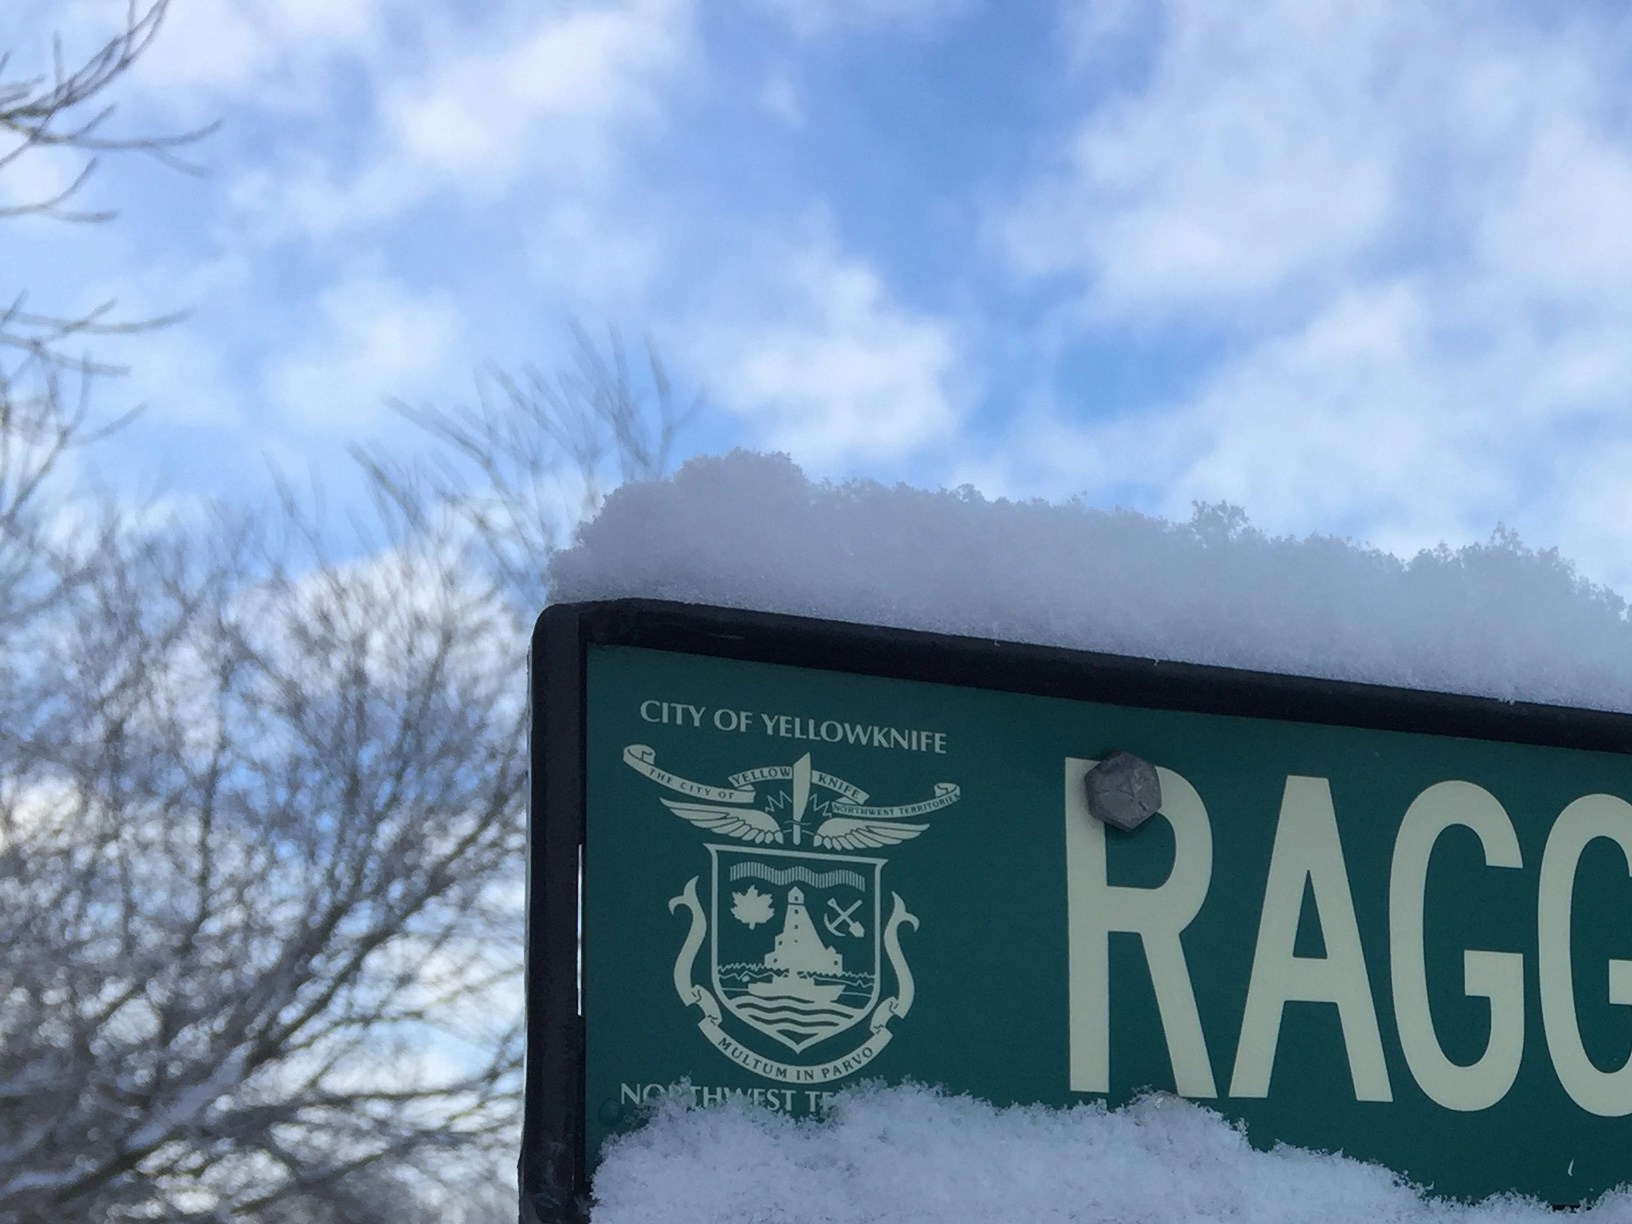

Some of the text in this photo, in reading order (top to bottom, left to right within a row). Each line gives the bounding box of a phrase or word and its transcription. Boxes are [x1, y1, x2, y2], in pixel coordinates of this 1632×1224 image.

[640, 700, 947, 755] CITY OF YELLOWKNIFE
[649, 767, 960, 816] THE CITY OF YELLOW KNIFE NORTHWEST TERRITORIES
[717, 1036, 874, 1081] MULTUM IN PARVO
